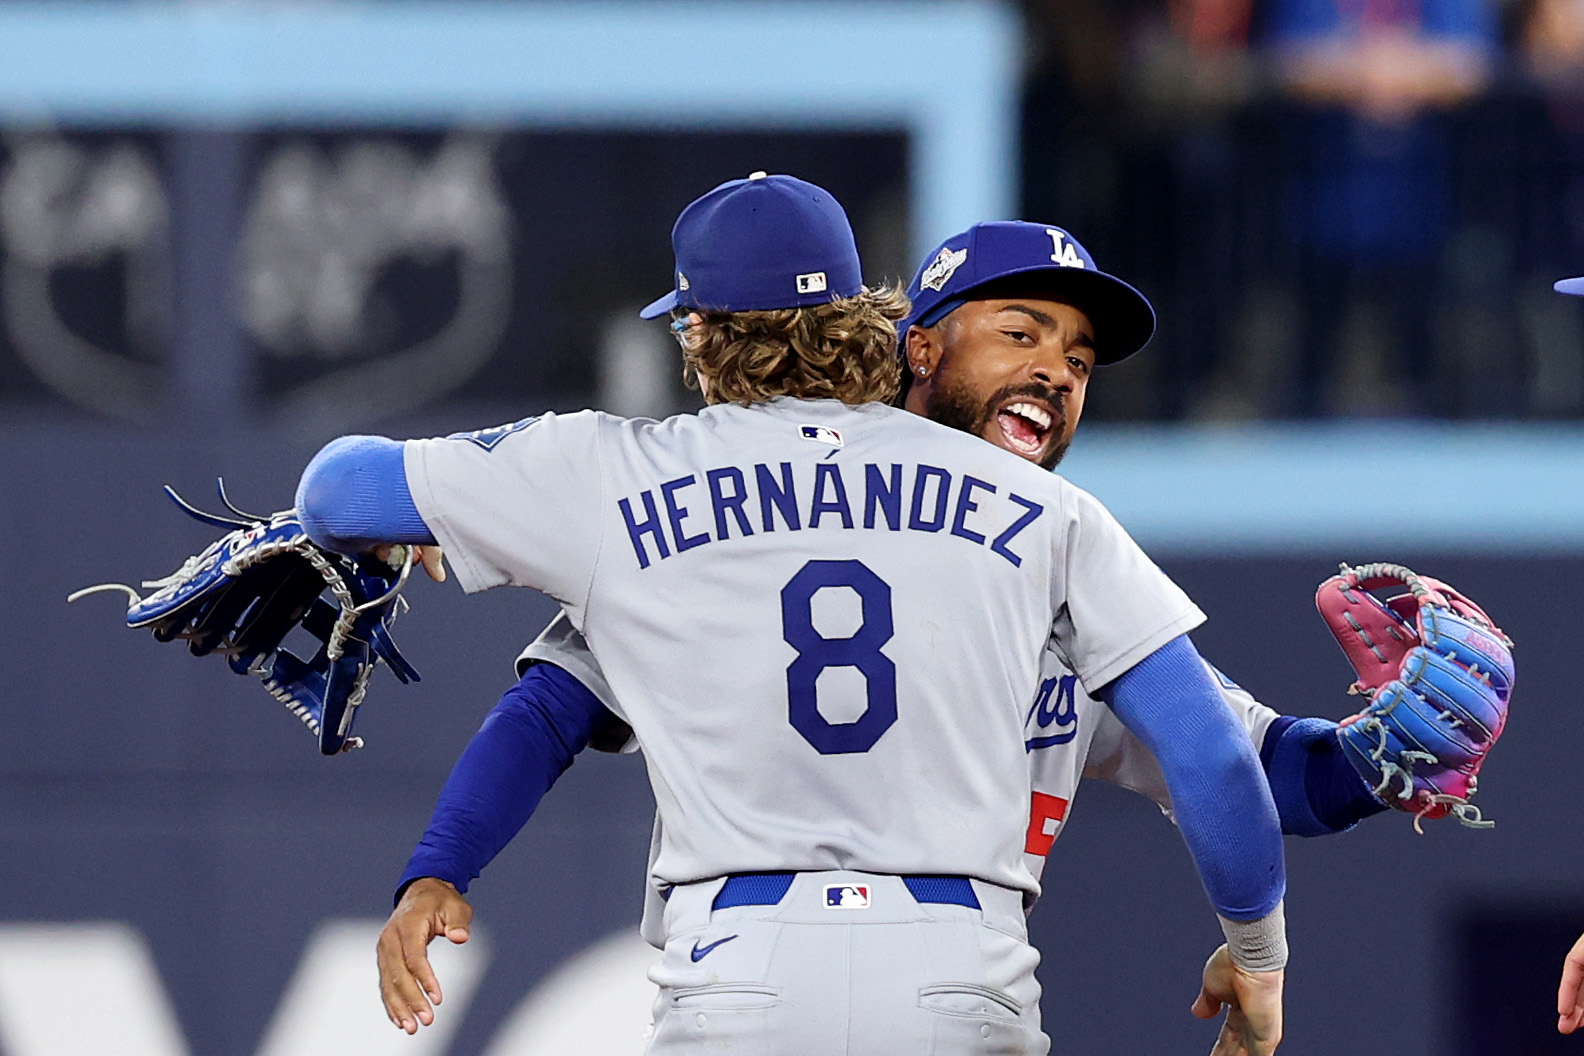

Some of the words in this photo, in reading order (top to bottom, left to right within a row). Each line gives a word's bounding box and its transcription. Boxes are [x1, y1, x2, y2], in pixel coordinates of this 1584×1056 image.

[1046, 228, 1085, 268] LA
[618, 449, 1045, 569] HERNÁNDEZ
[780, 559, 899, 755] 8
